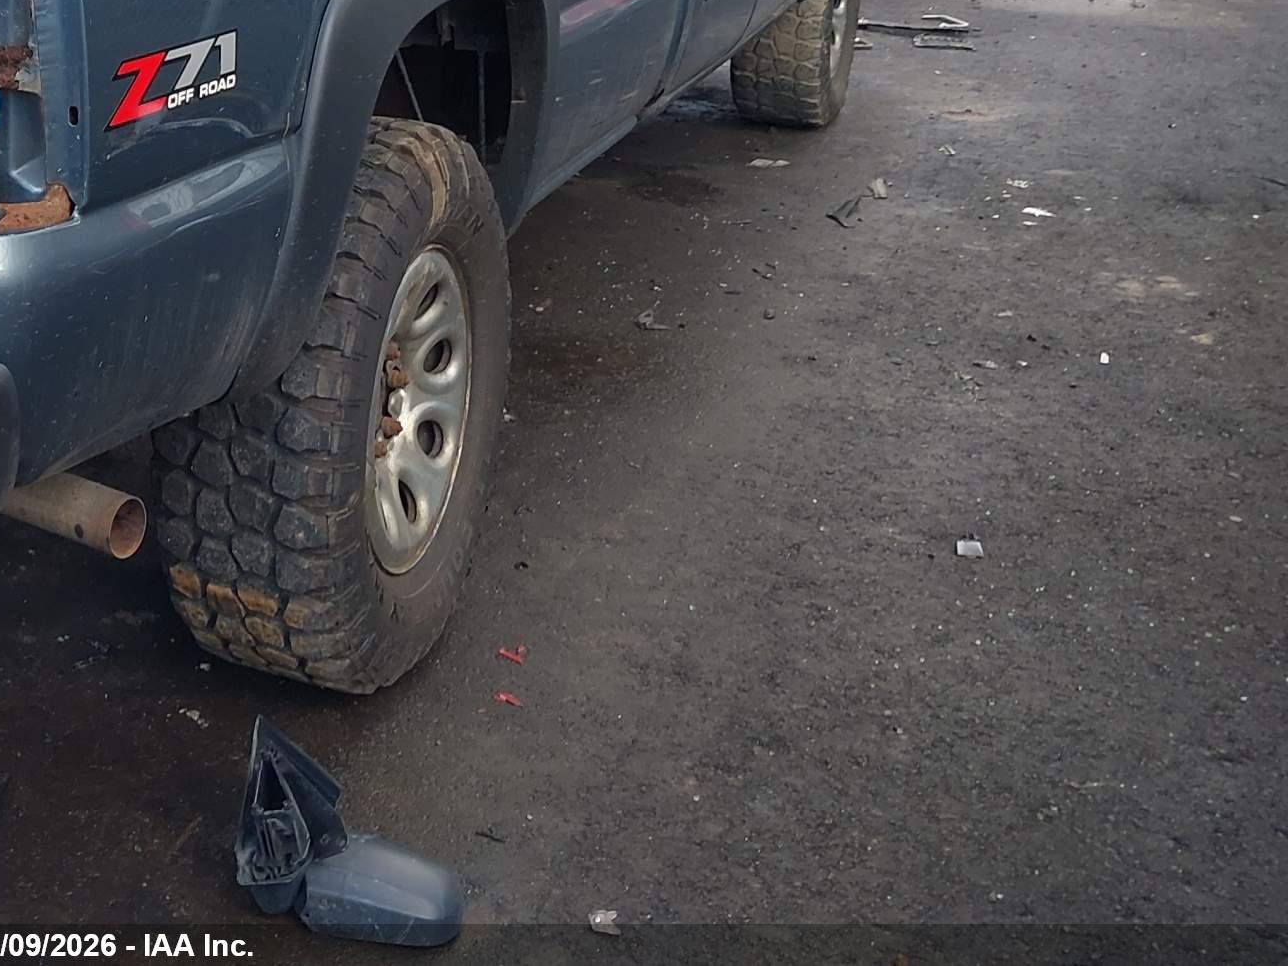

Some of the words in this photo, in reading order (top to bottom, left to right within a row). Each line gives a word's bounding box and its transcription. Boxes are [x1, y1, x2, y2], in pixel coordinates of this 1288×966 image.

[105, 29, 238, 131] Z71
[167, 87, 195, 109] OFF
[199, 74, 237, 99] ROAD
